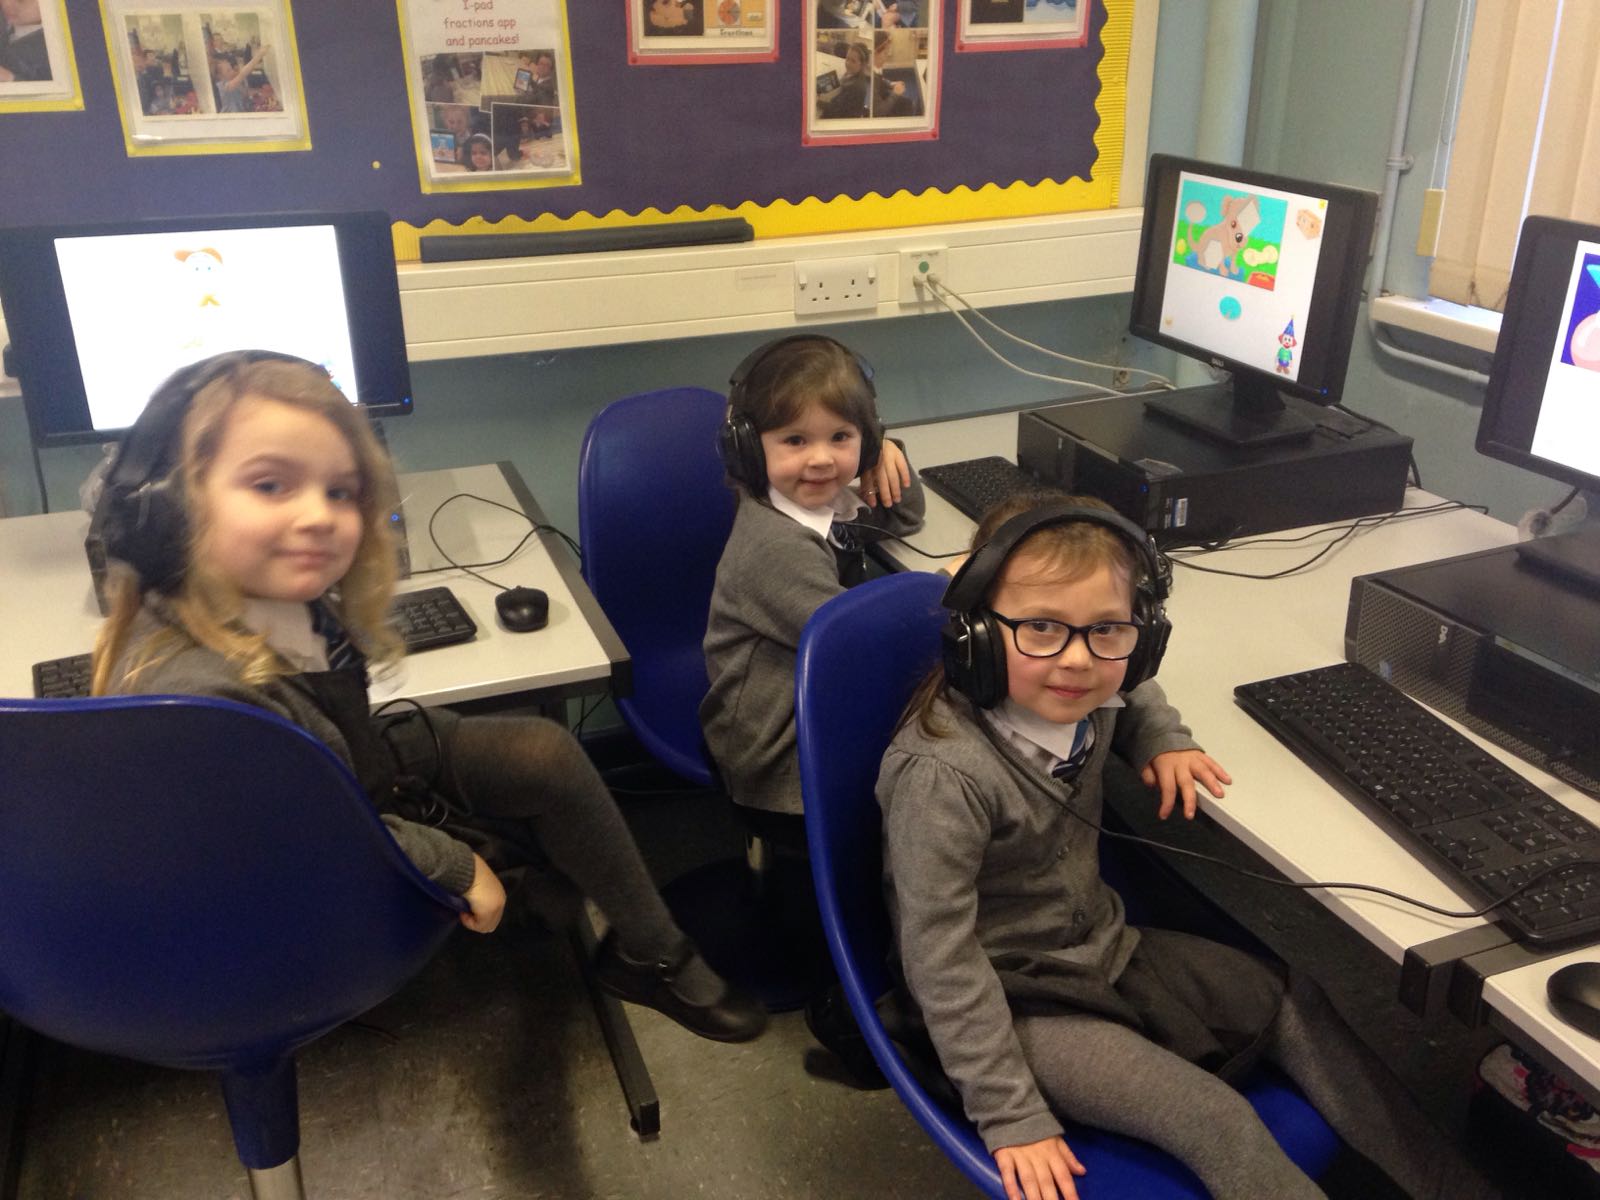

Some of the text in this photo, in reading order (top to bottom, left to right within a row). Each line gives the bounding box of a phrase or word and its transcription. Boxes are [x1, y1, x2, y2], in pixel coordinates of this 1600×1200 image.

[463, 0, 493, 12] I-pad
[443, 17, 516, 29] fractions app
[446, 34, 519, 48] and pancakes!
